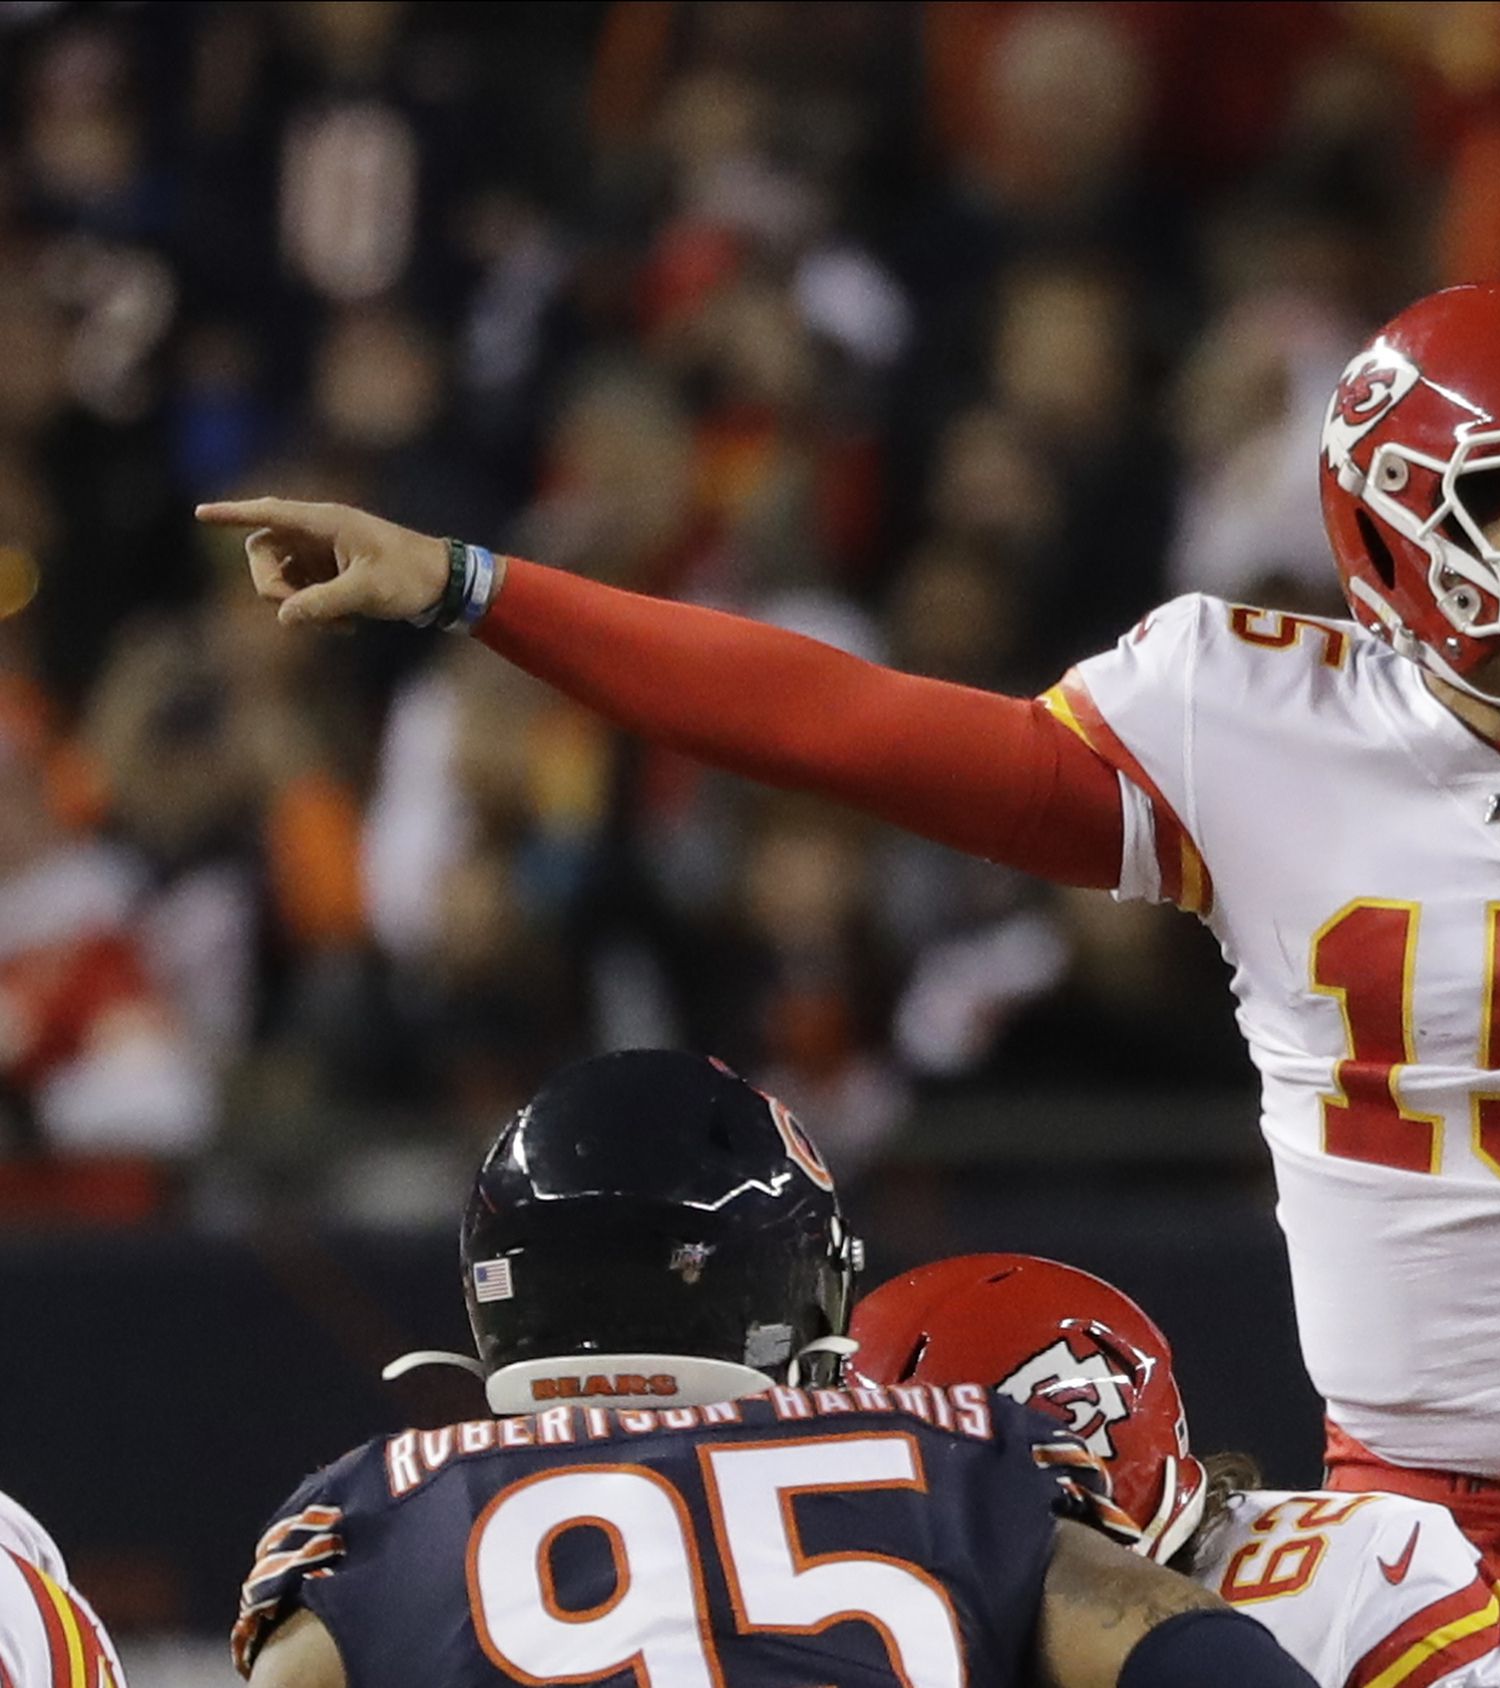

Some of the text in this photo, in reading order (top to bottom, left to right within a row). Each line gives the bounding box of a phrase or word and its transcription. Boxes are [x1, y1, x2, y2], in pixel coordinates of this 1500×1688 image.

[531, 1371, 678, 1400] BEARS
[466, 1430, 967, 1688] 95
[1216, 1494, 1387, 1607] 62
